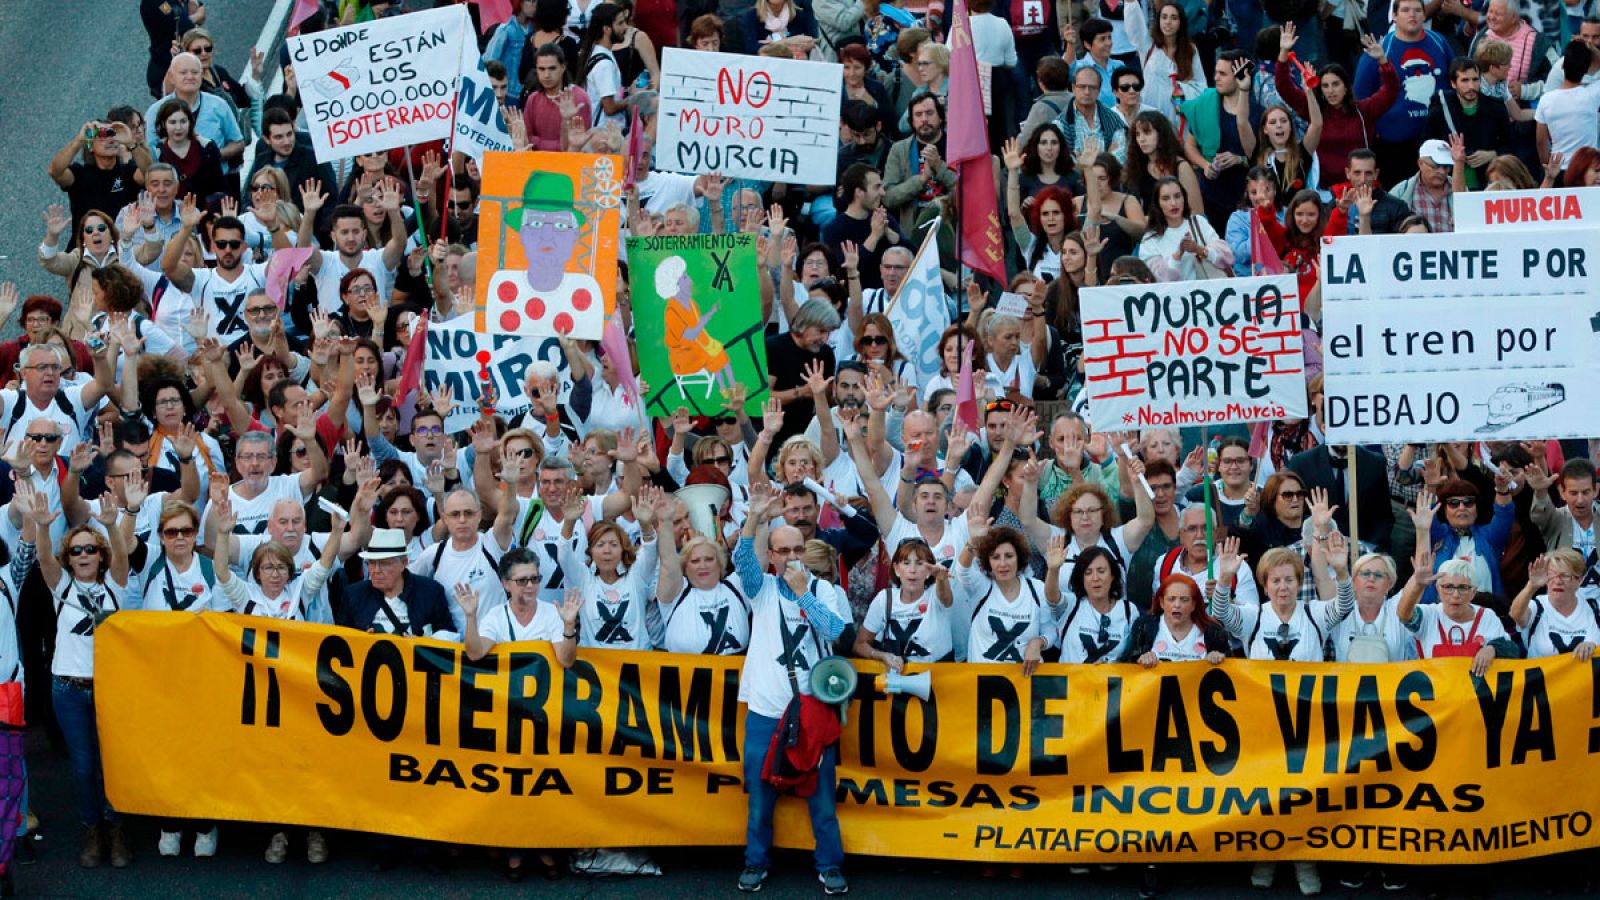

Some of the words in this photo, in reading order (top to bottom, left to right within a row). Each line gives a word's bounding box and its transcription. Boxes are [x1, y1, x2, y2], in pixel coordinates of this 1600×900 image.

[369, 29, 446, 63] ESTÁN
[369, 62, 417, 85] LOS
[717, 67, 772, 109] NO
[327, 98, 457, 148] ¡SOTERRADO
[679, 108, 764, 140] MURO
[677, 141, 799, 175] MURCIA
[1484, 195, 1583, 225] MURCIA
[710, 250, 735, 293] YA
[1326, 253, 1367, 285] LA
[1392, 249, 1499, 282] GENTE
[1522, 247, 1588, 278] POR
[1123, 283, 1283, 334] MURCIA
[427, 329, 478, 361] NO
[1164, 326, 1209, 356] NO
[1218, 325, 1263, 356] SE
[1329, 324, 1364, 359] el
[1381, 327, 1474, 356] tren
[1496, 327, 1557, 362] por
[1146, 356, 1271, 400] PARTE
[1121, 400, 1287, 427] #NoalmuroMurcia
[1328, 391, 1460, 428] DEBAJO
[315, 635, 938, 772] SOTERRAMITO
[977, 675, 1069, 777] DE
[1106, 668, 1241, 776] LAS
[1270, 670, 1438, 774] VIAS
[1470, 666, 1556, 769] YA
[389, 752, 574, 796] BASTA
[604, 767, 675, 796] DE
[707, 773, 1042, 811] PMESAS
[1072, 783, 1485, 816] INCUMPLIDAS
[974, 825, 1197, 853] PLATAFORMA
[1214, 811, 1592, 852] PRO-SOTERRAMIENTO
